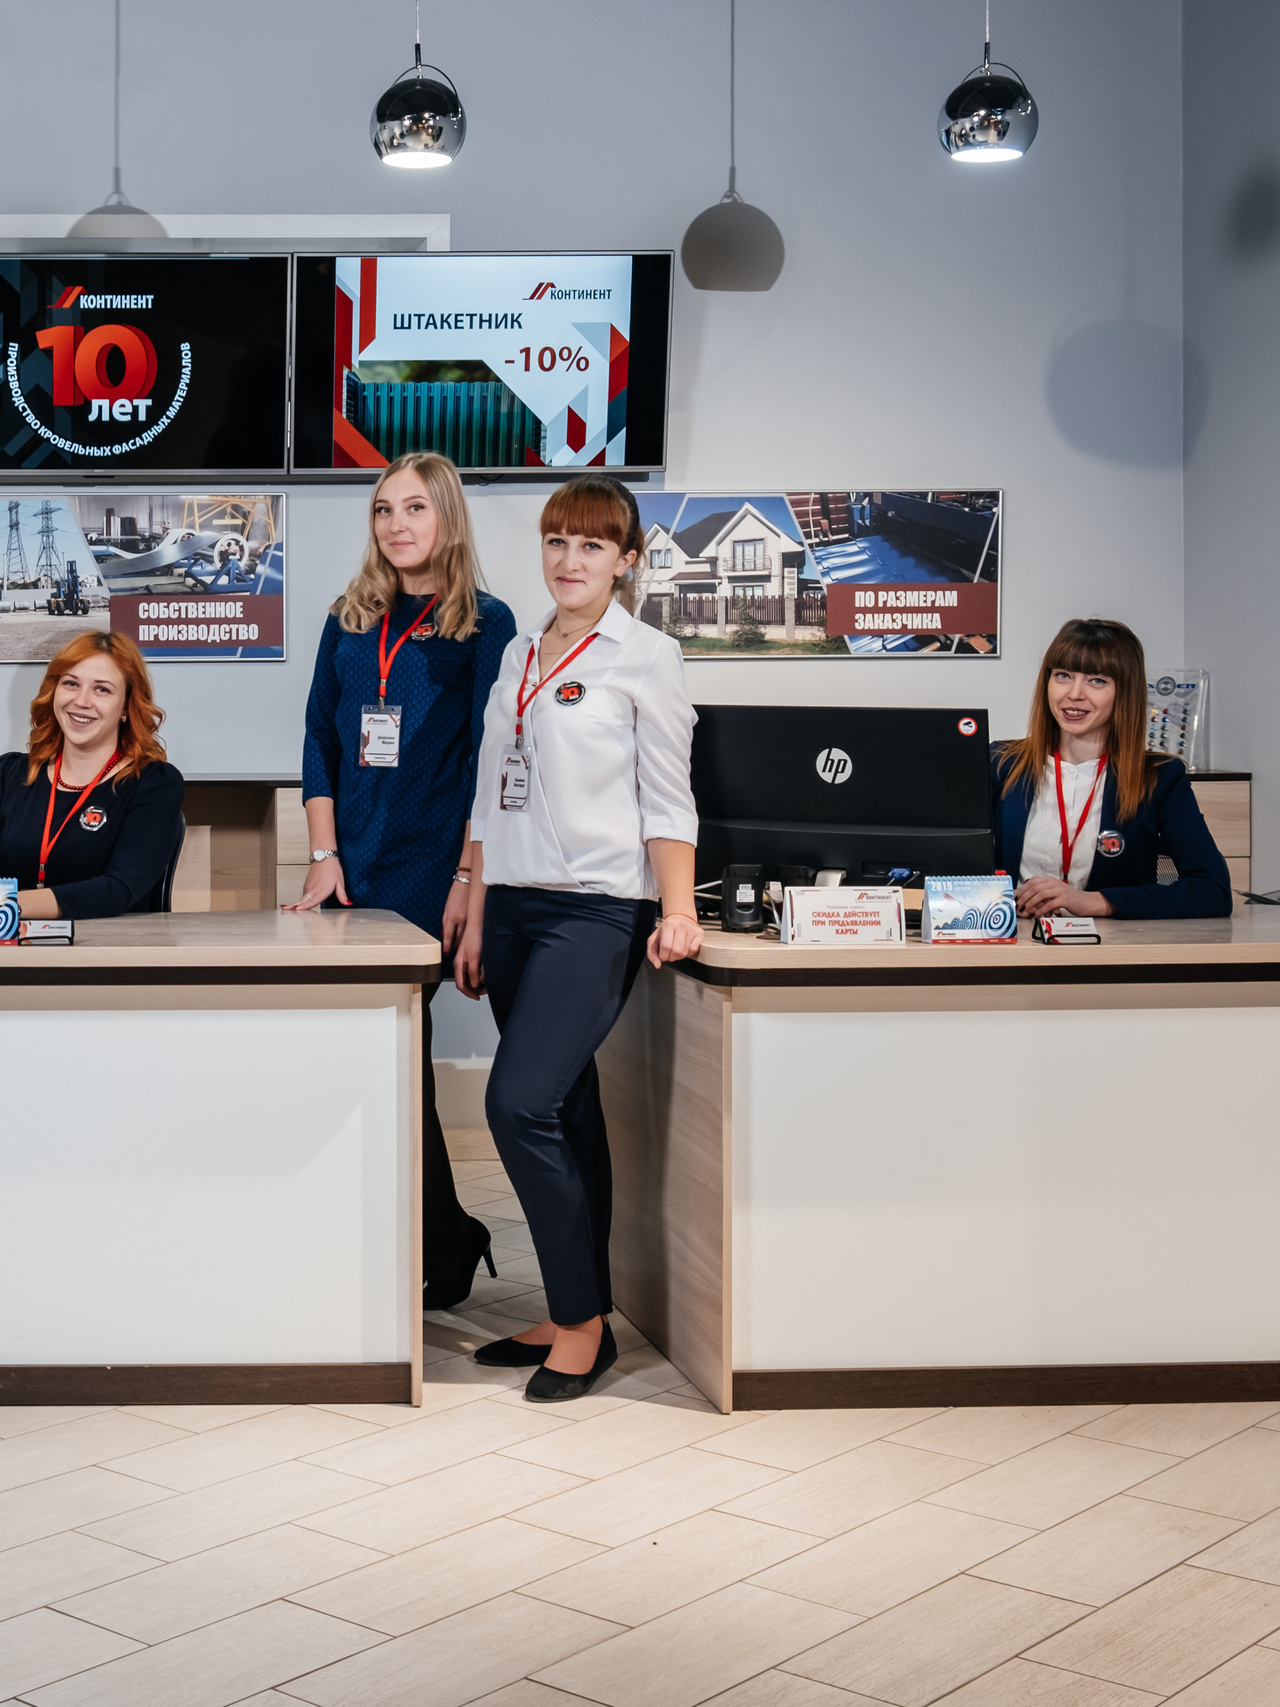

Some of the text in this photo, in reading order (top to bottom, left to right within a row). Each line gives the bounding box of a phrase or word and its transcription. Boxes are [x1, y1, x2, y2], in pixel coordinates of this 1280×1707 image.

[79, 295, 154, 309] КОНТИНЕНТ
[549, 288, 613, 301] КОНТИНЕНТ
[392, 312, 524, 331] ШТАКЕТНИК
[35, 324, 158, 407] 10
[504, 345, 590, 373] -10%
[6, 341, 192, 457] ПРОИЗВОДСТВО КРОВЕЛЬНЫХ ФАСАДНЫХ МАТЕРИАЛОВ
[88, 398, 153, 422] лет
[854, 590, 958, 608] ПО РАЗМЕРАМ
[138, 601, 244, 619] СОБСТВЕННОЕ
[854, 612, 942, 630] ЗАКАЗЧИКА
[138, 623, 259, 643] ПРОИЗВОДСТВО
[819, 748, 849, 783] hp
[843, 910, 880, 919] ДЕЙСТВУЕТ
